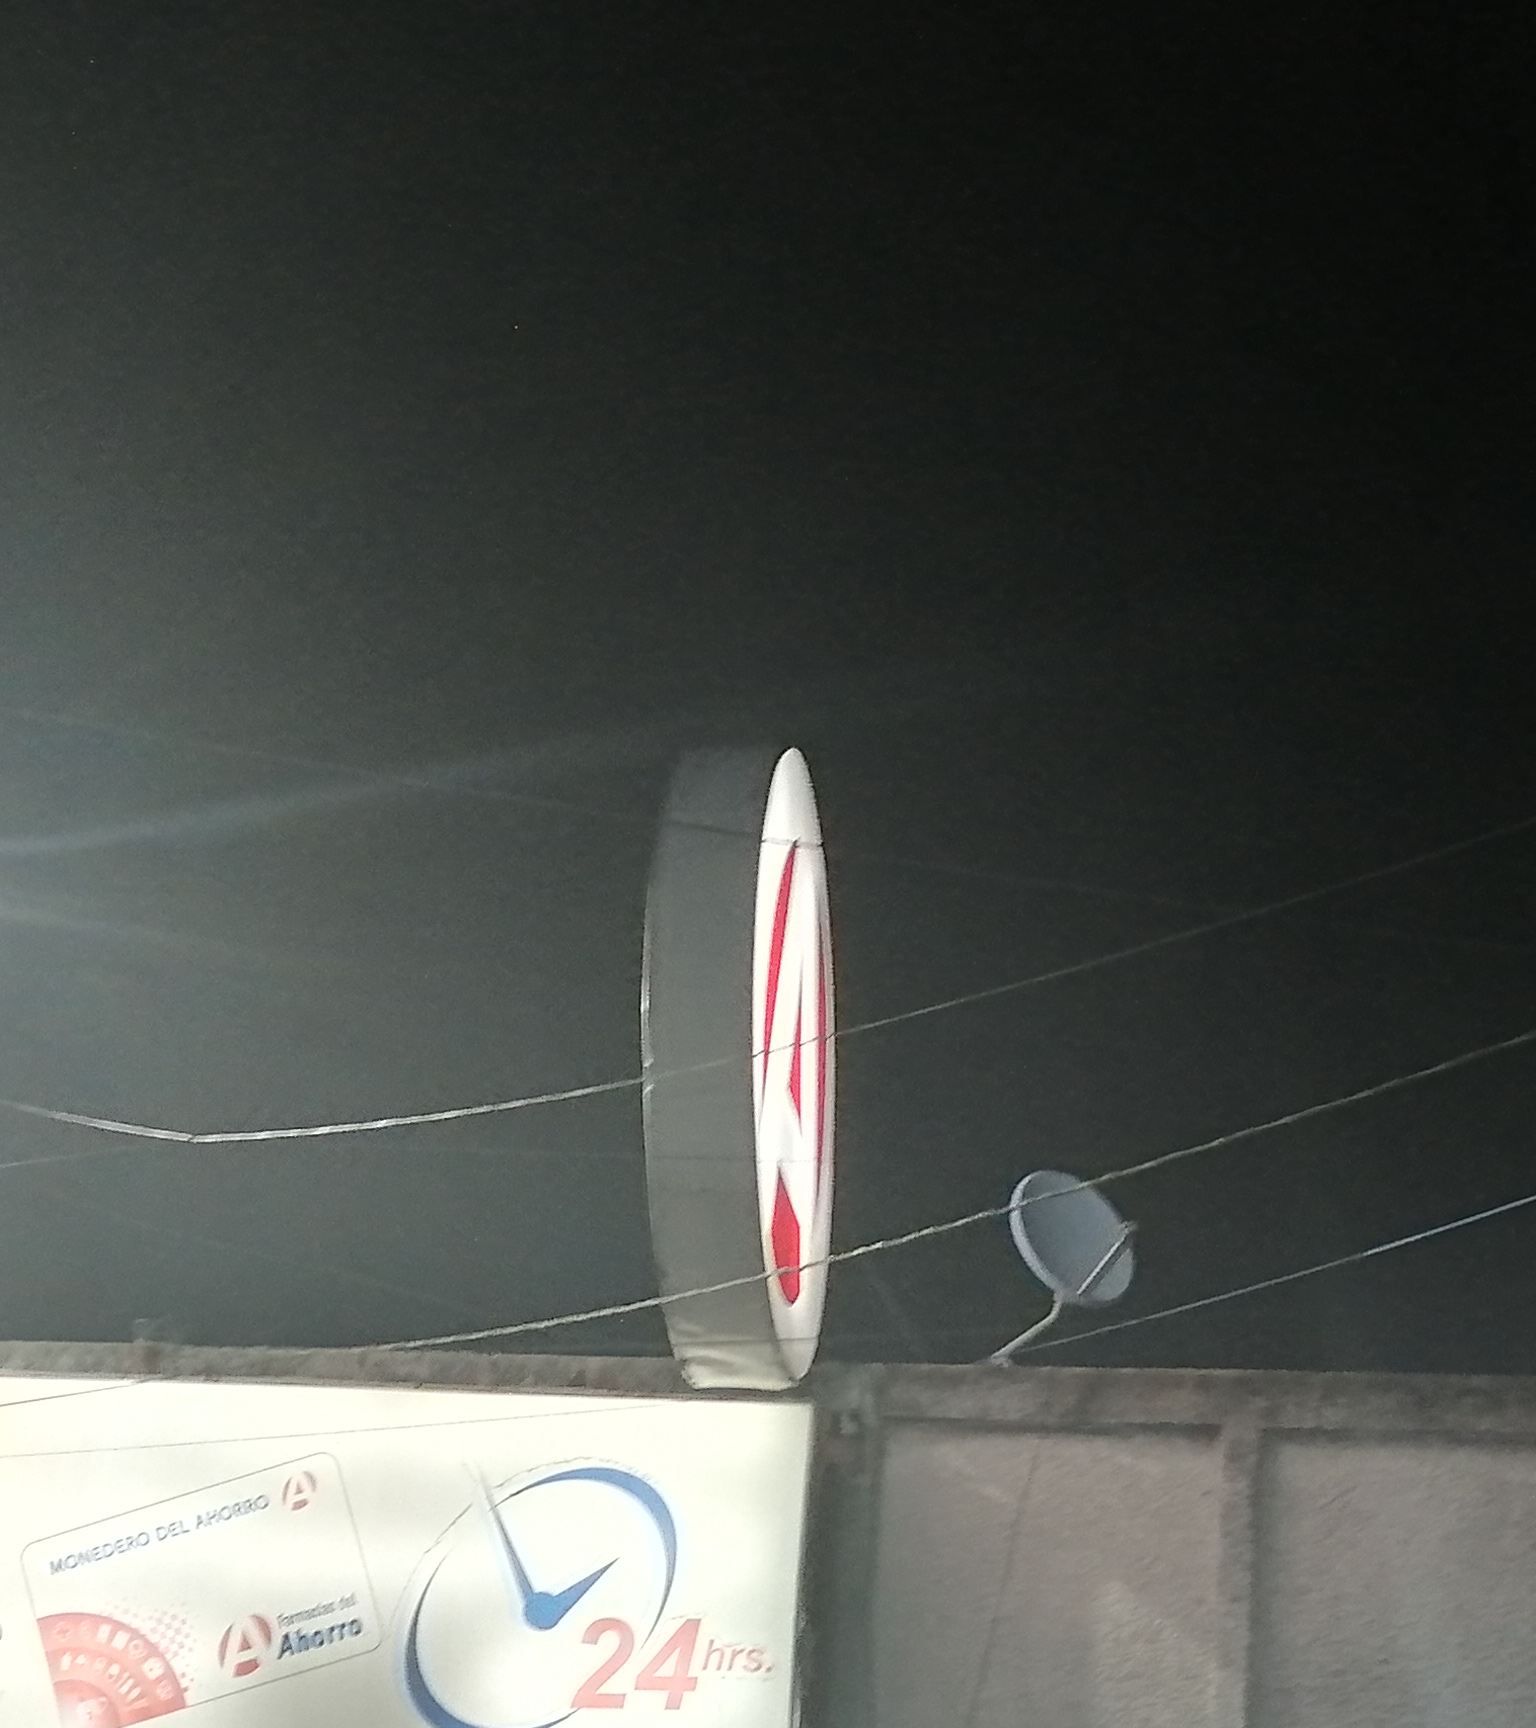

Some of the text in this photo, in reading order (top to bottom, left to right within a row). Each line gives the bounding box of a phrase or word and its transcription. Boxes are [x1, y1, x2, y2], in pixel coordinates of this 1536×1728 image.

[49, 1531, 151, 1577] MONEDERO
[155, 1519, 191, 1543] DEL
[195, 1494, 271, 1531] AHORRO
[276, 1618, 364, 1661] Ahorro
[570, 1616, 775, 1711] 24 hrs.
